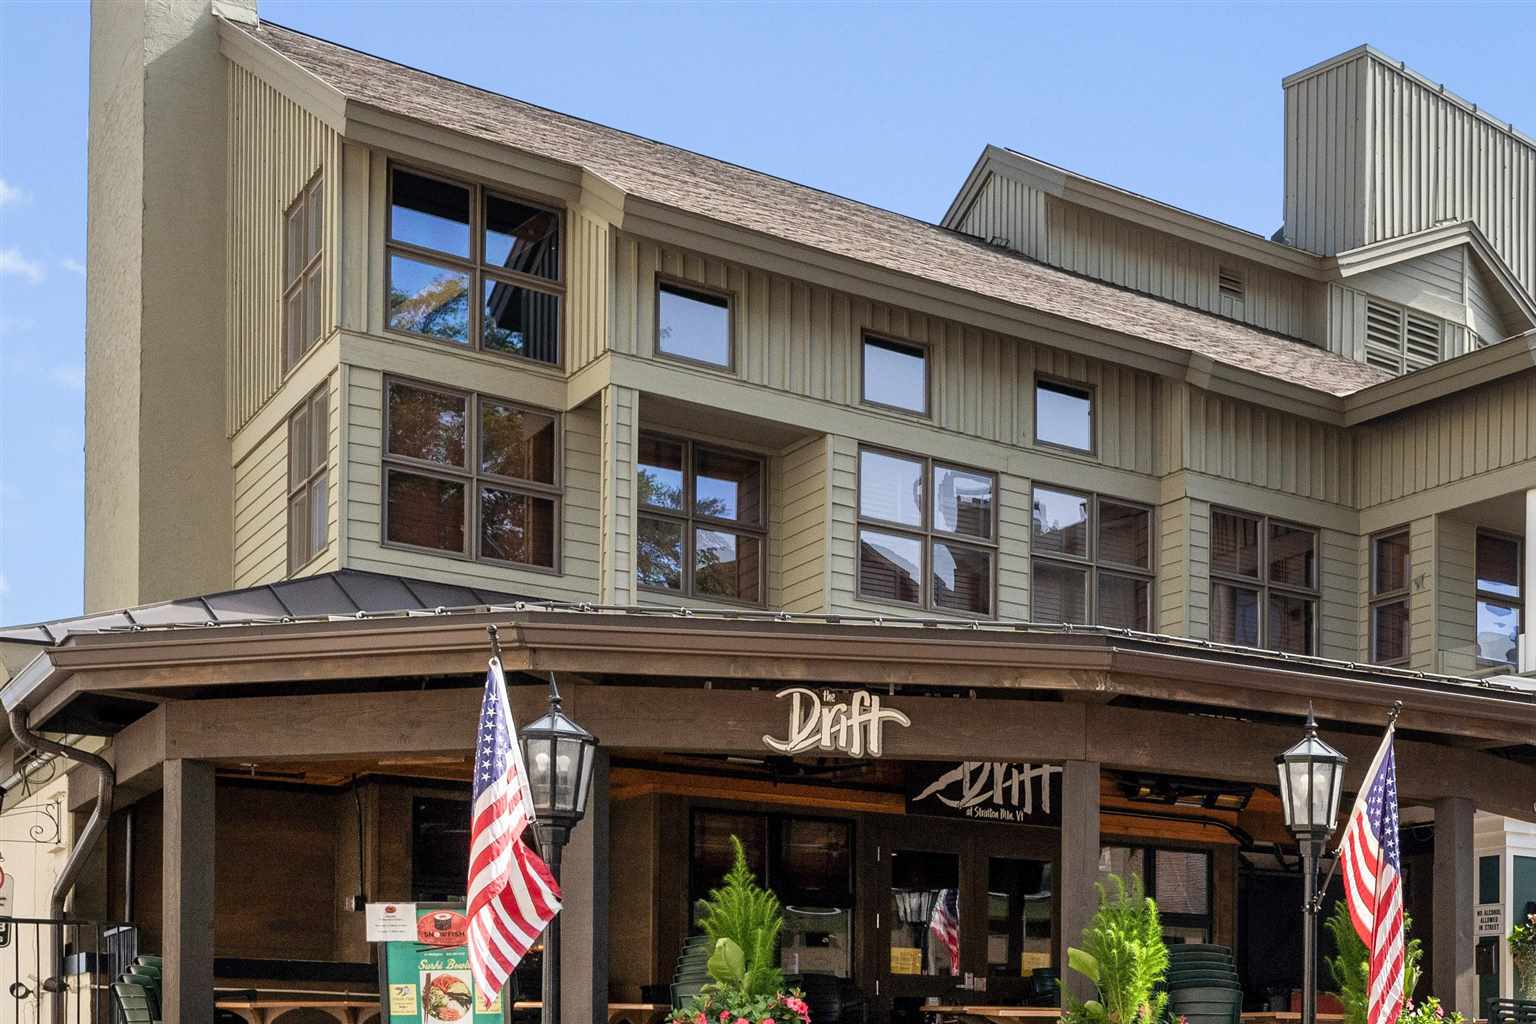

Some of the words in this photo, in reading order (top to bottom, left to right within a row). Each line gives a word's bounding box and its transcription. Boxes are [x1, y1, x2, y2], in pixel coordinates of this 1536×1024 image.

[823, 690, 836, 702] the
[762, 687, 912, 757] Drift
[418, 959, 443, 969] Sushi
